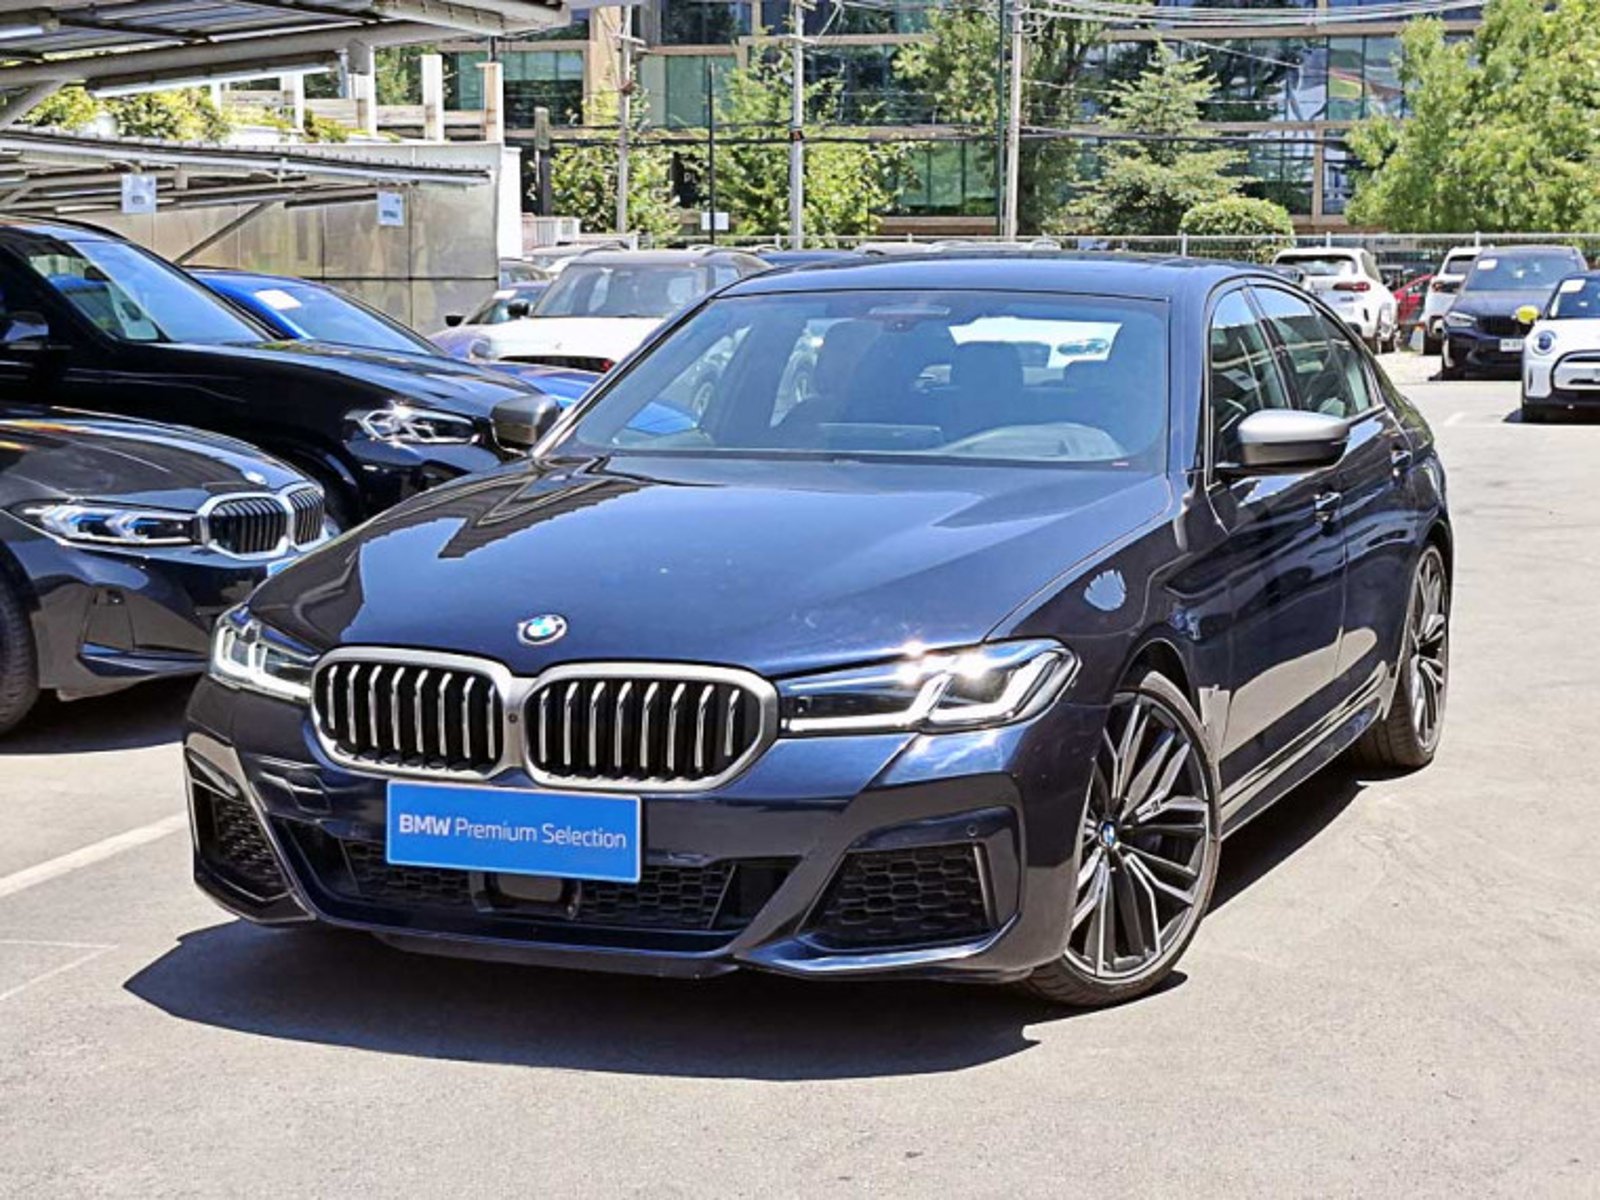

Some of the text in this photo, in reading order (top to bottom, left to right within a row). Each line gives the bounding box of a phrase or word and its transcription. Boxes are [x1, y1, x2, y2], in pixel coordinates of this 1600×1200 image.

[399, 813, 627, 849] BMW Premium Selection
